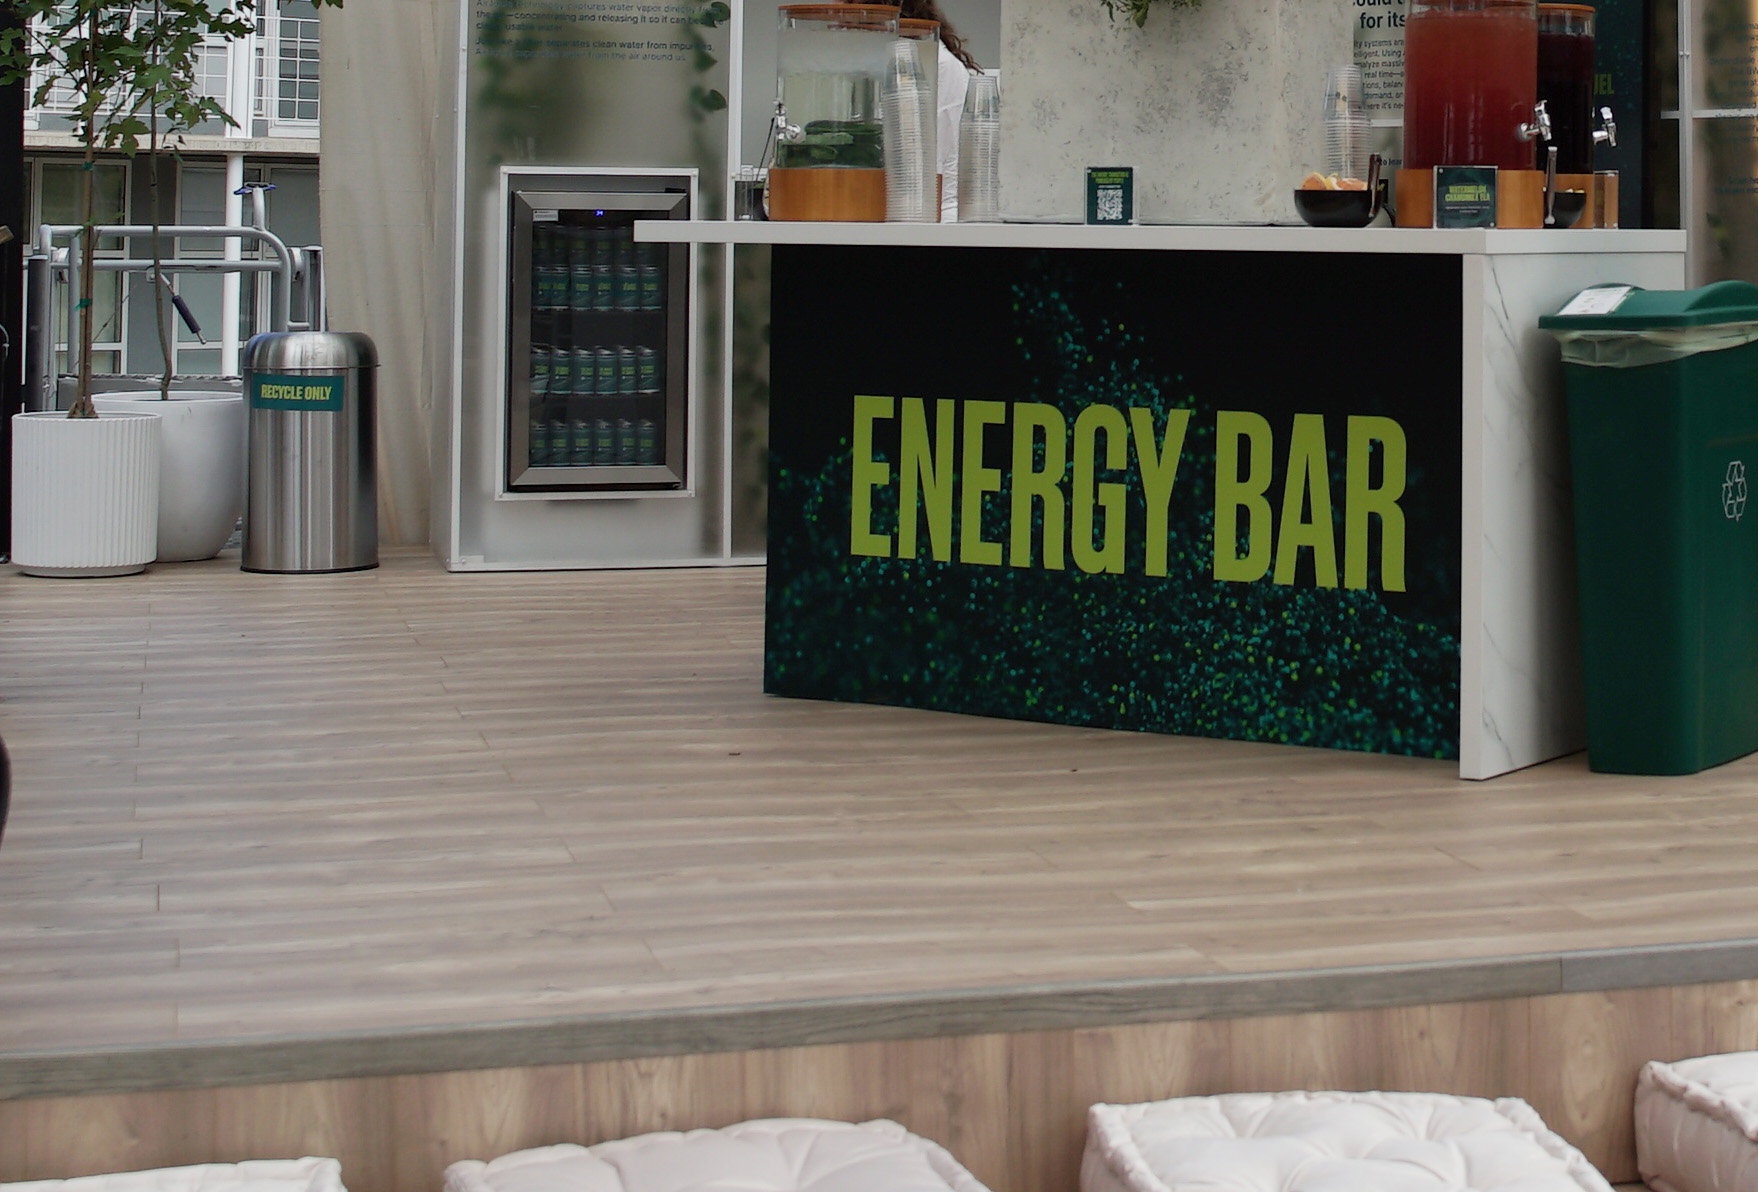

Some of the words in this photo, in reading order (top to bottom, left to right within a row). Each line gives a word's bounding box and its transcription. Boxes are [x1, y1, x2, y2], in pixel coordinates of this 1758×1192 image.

[1360, 12, 1384, 29] for
[619, 40, 644, 49] water
[646, 40, 668, 50] from
[260, 383, 304, 400] RECYCLE
[304, 385, 332, 401] ONLY
[850, 394, 1192, 578] ENERGY
[1212, 409, 1408, 593] BAR
